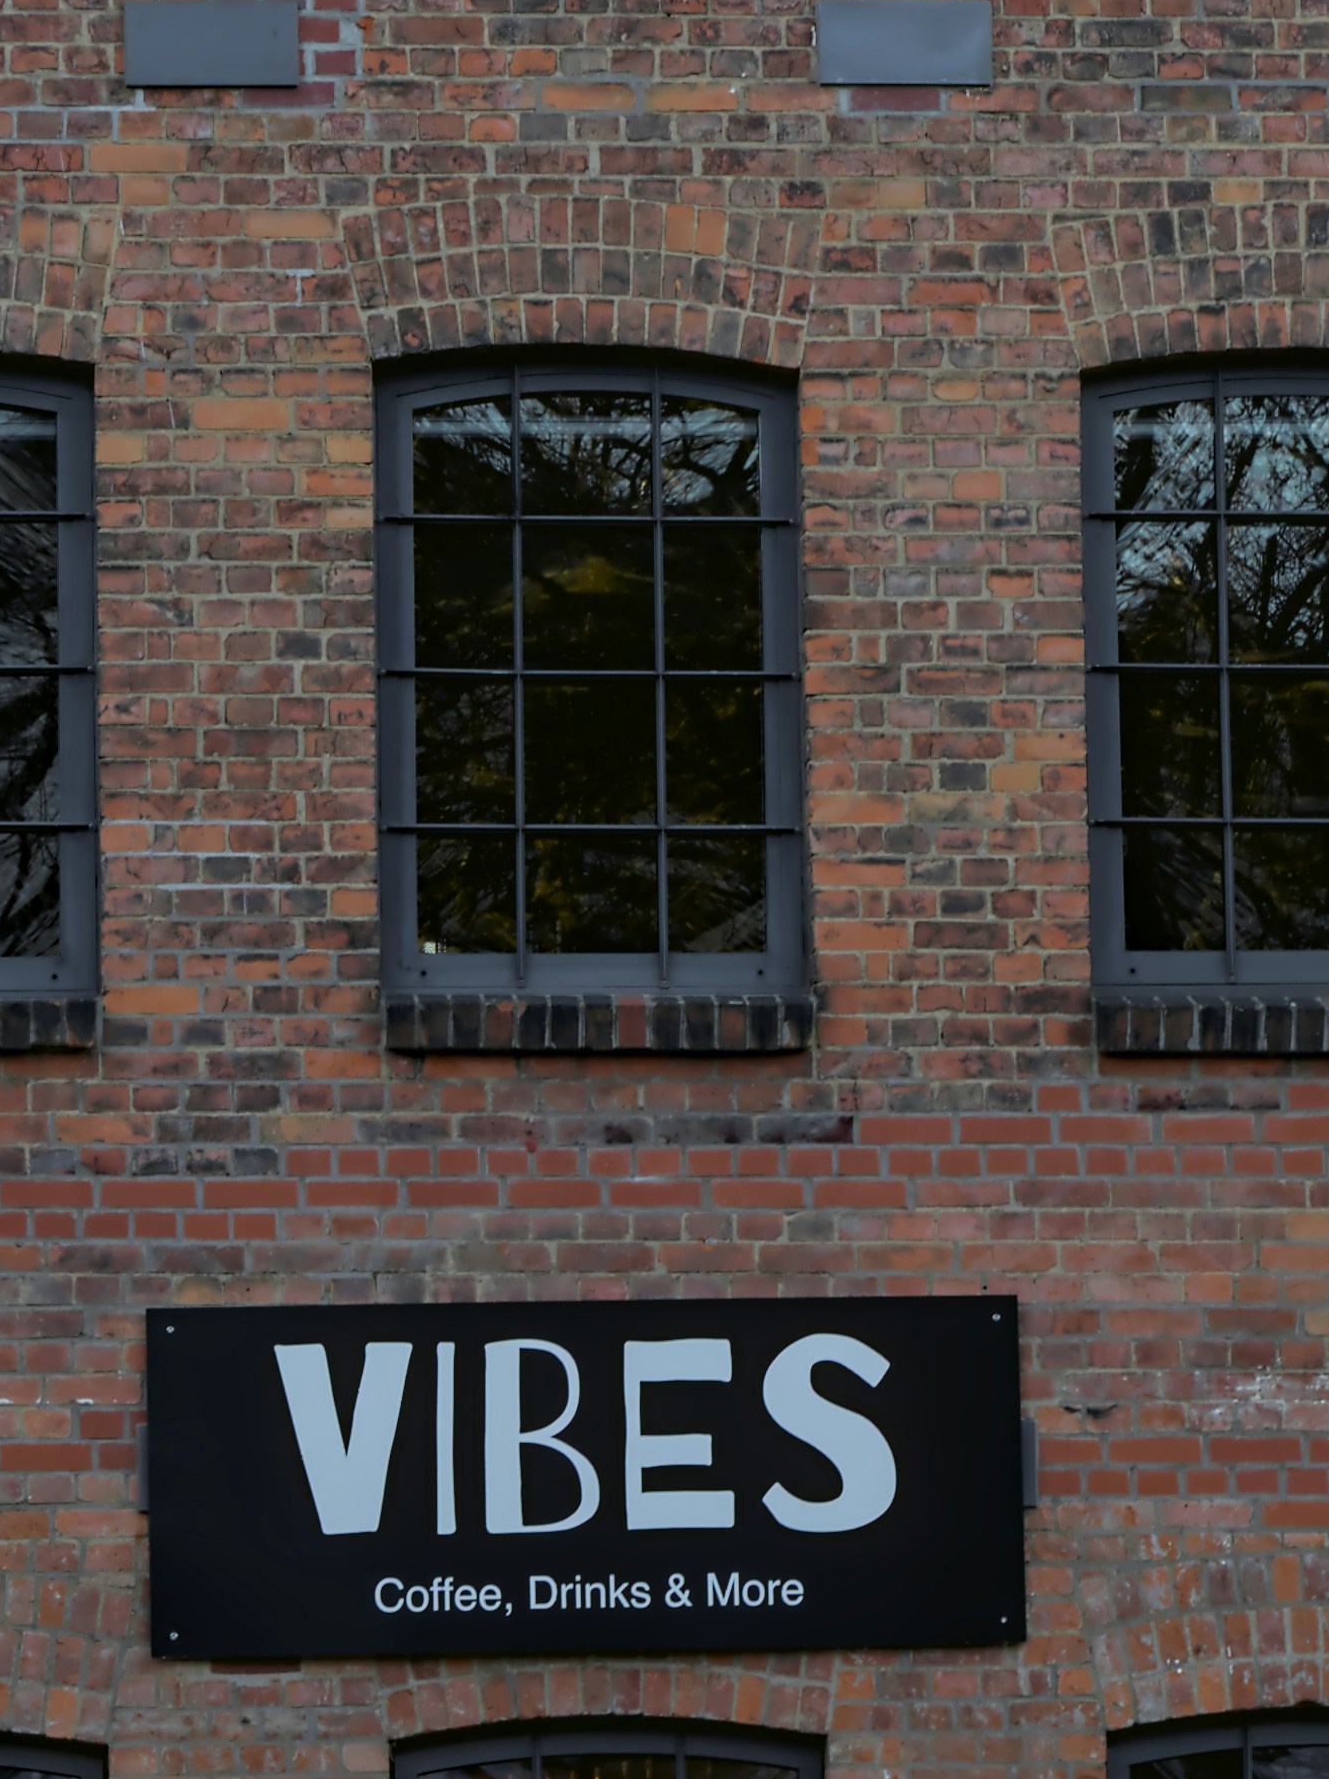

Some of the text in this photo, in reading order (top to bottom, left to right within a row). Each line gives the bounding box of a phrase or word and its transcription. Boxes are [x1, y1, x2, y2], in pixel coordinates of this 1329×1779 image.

[273, 1332, 897, 1536] VIBES
[374, 1571, 805, 1617] Coffee, Drinks & More
